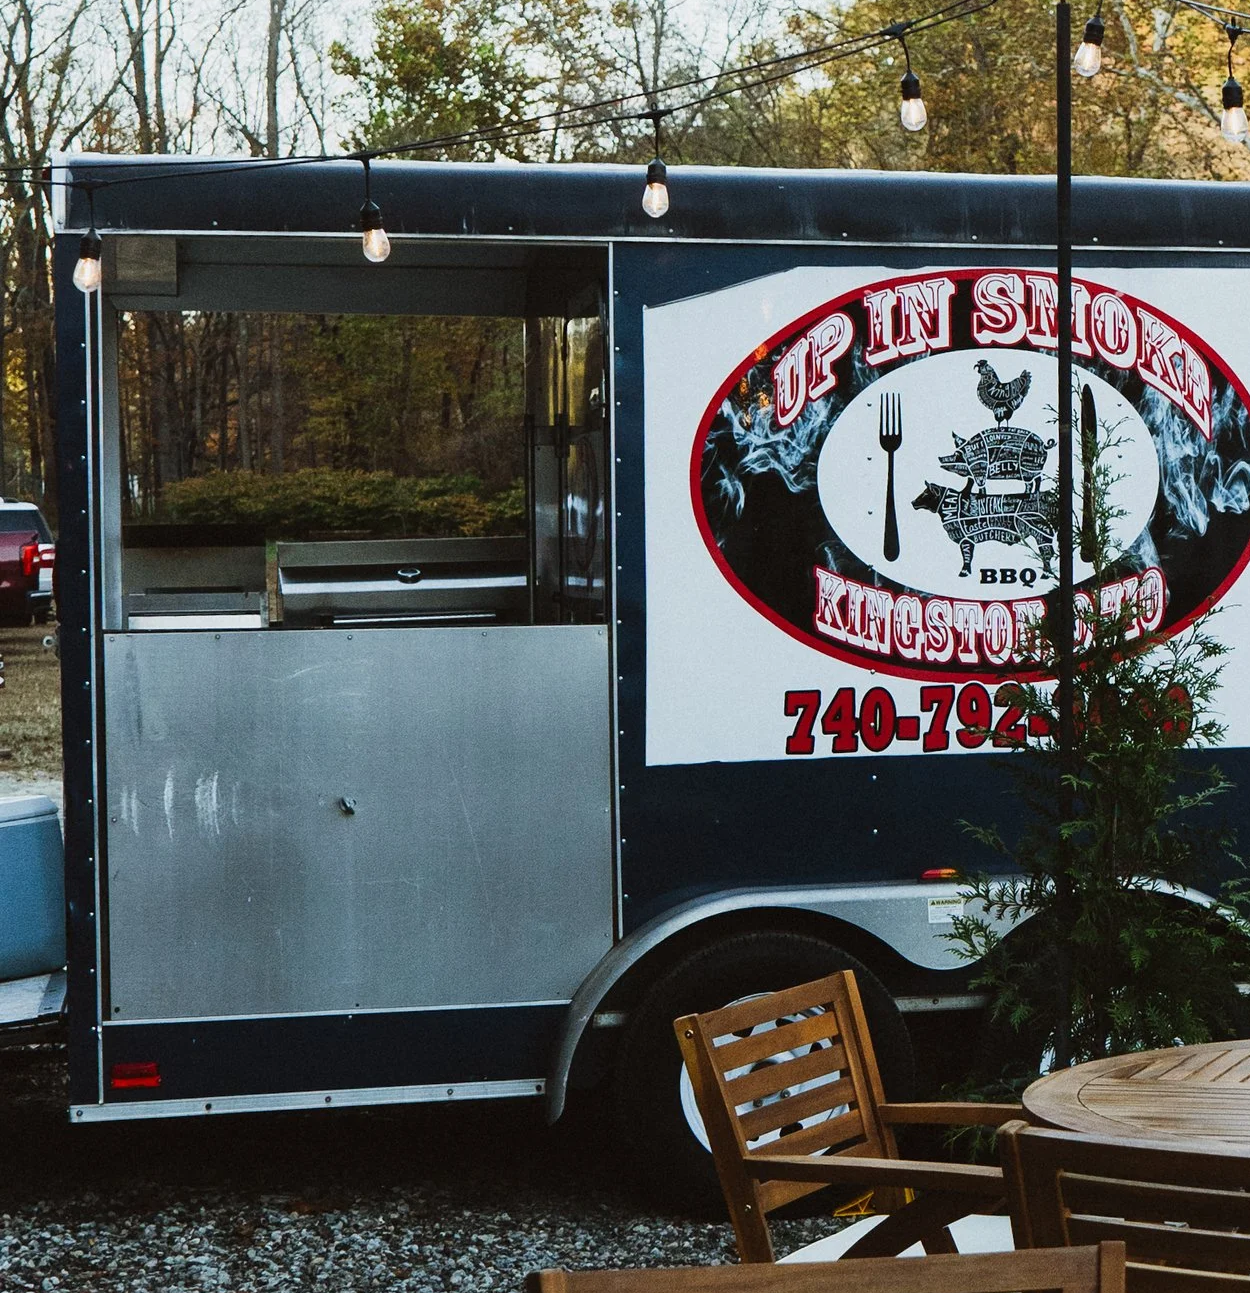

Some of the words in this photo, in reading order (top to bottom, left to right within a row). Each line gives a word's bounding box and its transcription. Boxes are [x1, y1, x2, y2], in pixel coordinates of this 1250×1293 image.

[772, 312, 854, 428] UP
[865, 276, 955, 366] IN
[973, 271, 1213, 442] SMOKE
[989, 462, 1019, 476] BELLY
[942, 491, 958, 521] MEAT
[973, 530, 1016, 543] BUTCHERY
[979, 568, 1037, 588] BBQ
[813, 564, 1049, 667] KINGSTON
[785, 683, 1193, 754] 740-792-
